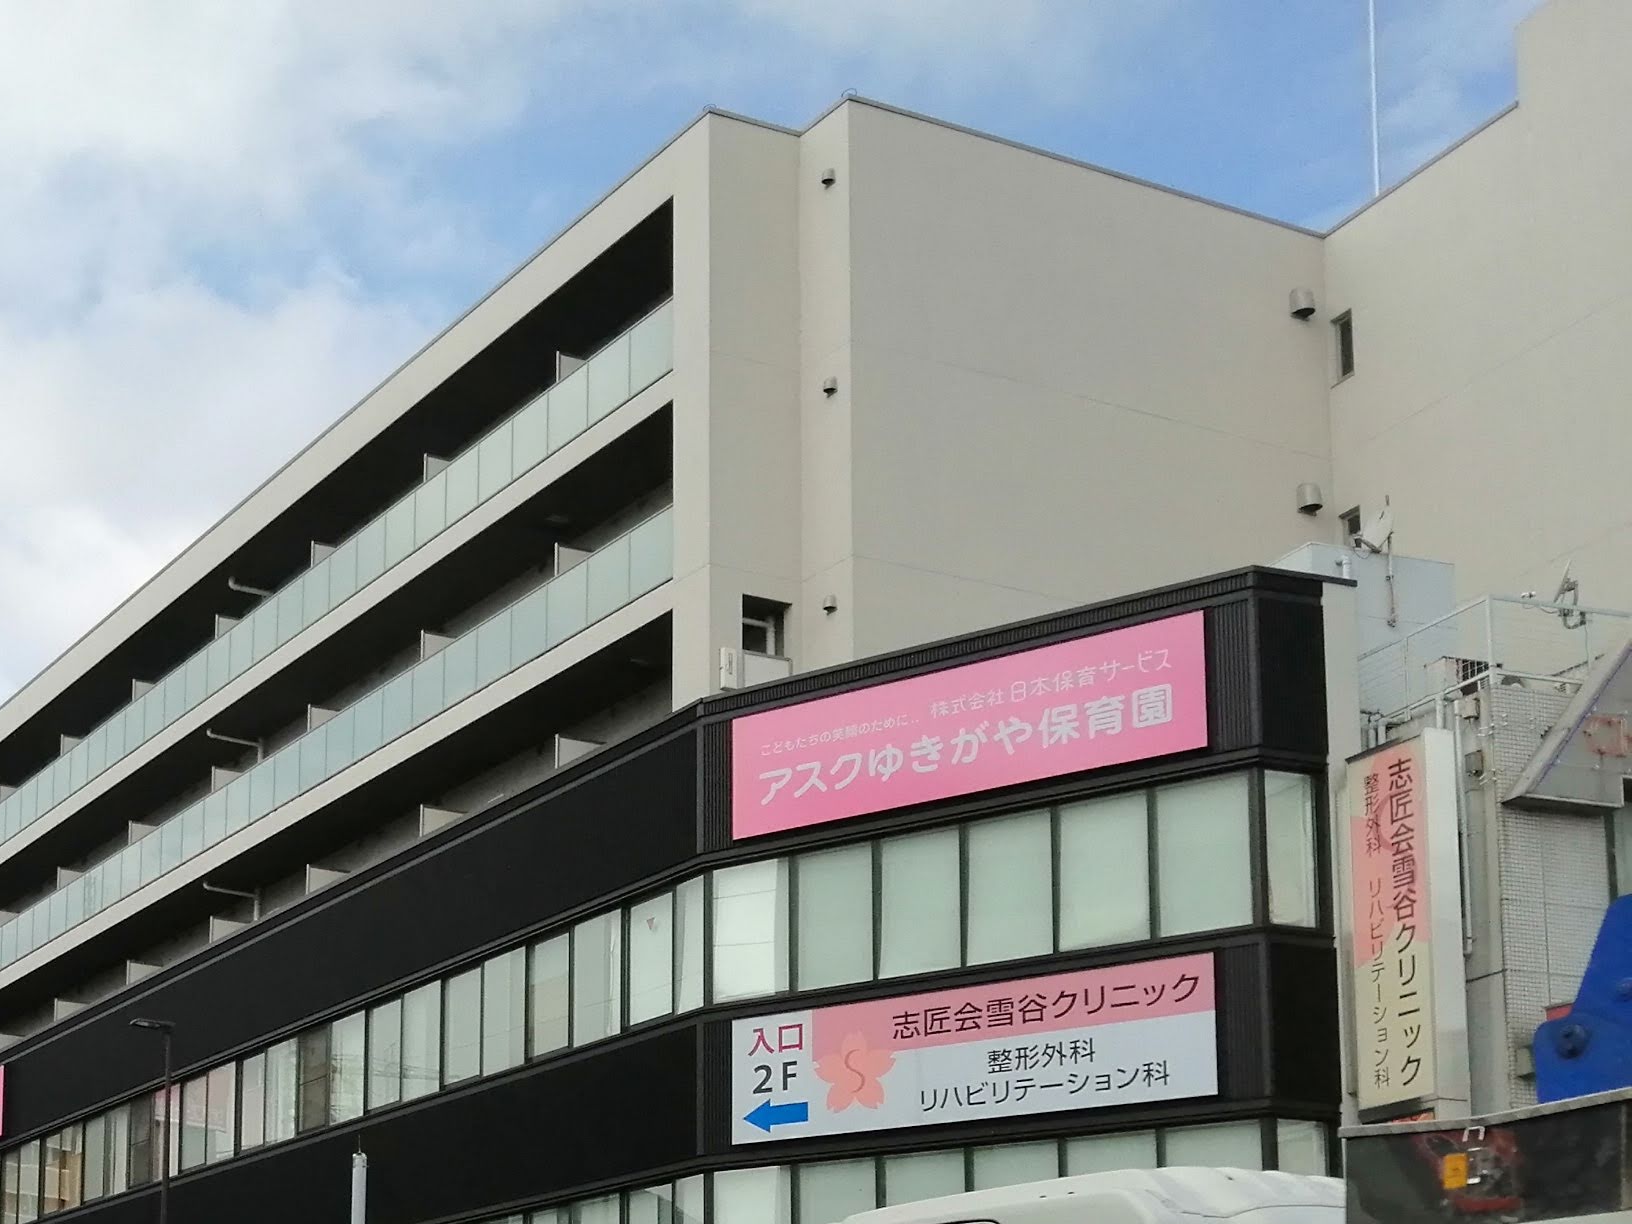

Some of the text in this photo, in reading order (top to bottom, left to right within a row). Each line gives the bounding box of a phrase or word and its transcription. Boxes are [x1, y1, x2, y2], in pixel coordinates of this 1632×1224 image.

[929, 687, 1005, 720] 株式会社
[1010, 648, 1173, 702] 日本保育サービス
[759, 683, 1174, 806] アスクゆきがや保育園
[1363, 771, 1391, 1088] 整形外科 リハビリテーション科
[1387, 757, 1422, 1088] 志匠会雪谷クリニック
[747, 1022, 804, 1057] 入口
[891, 972, 1201, 1041] 志匠会雪谷クリニック
[752, 1060, 799, 1096] 2F
[919, 1060, 1171, 1113] リハビリテーション科
[987, 1037, 1096, 1075] 整形外科
